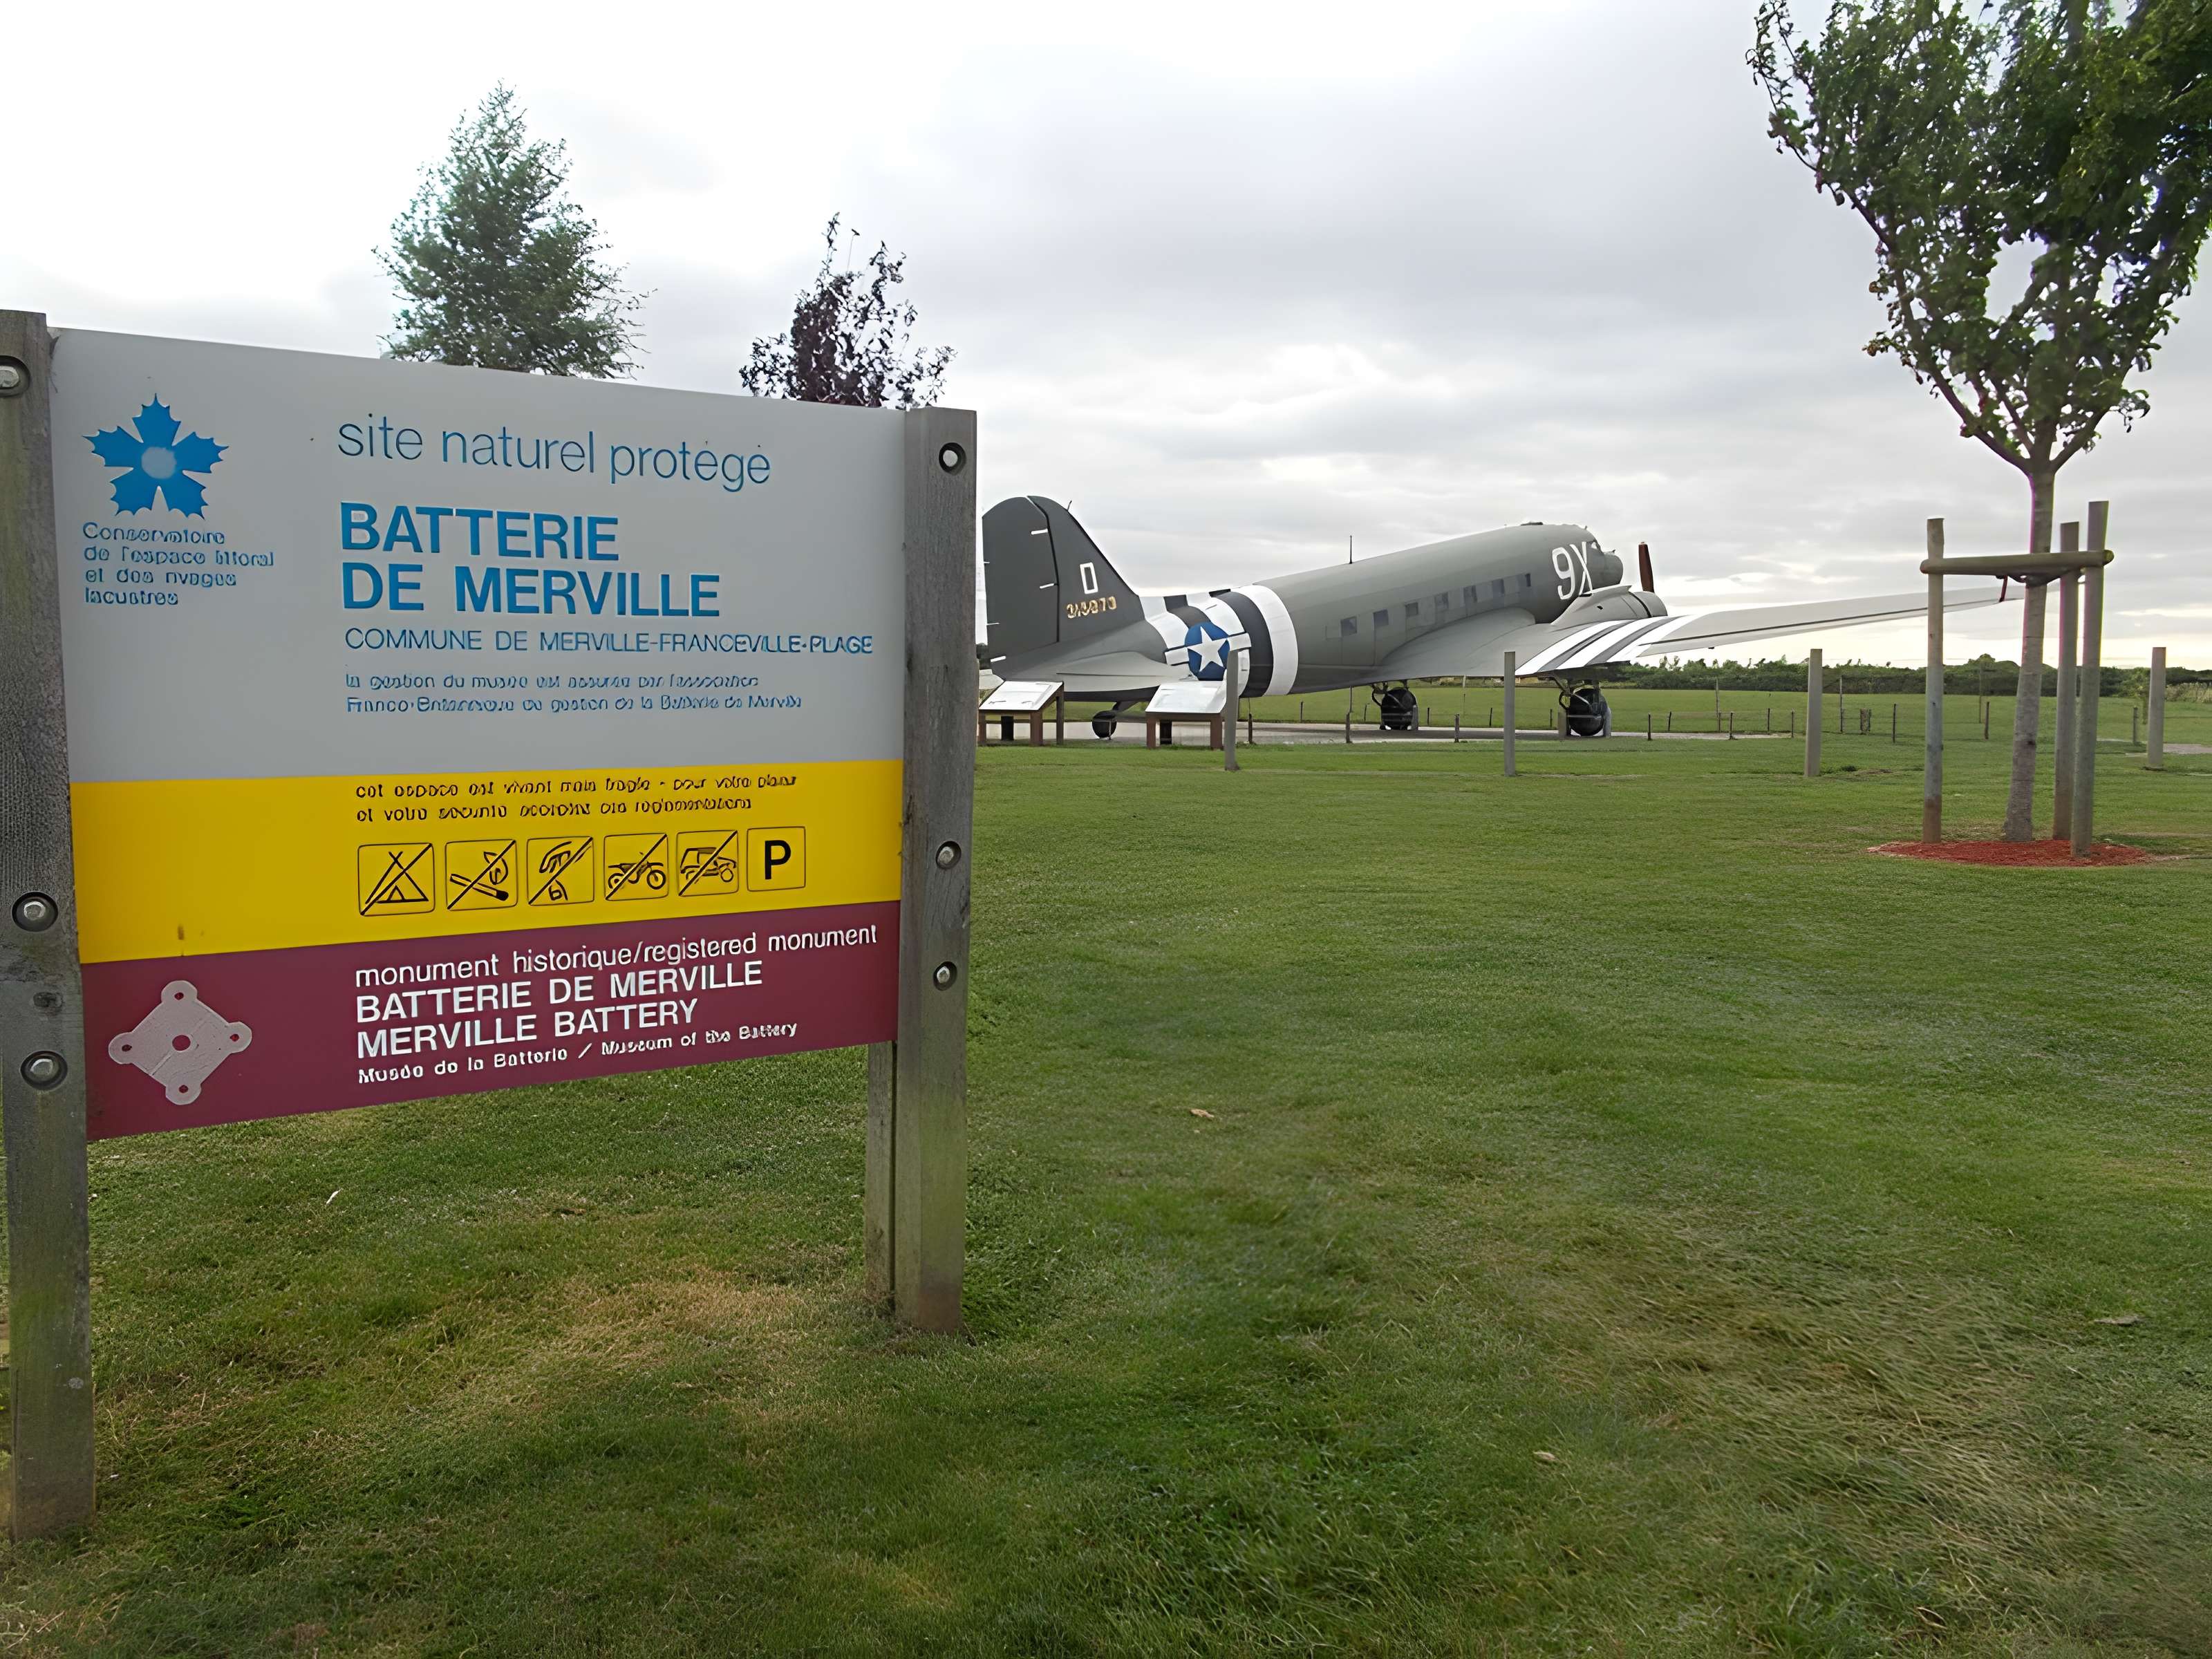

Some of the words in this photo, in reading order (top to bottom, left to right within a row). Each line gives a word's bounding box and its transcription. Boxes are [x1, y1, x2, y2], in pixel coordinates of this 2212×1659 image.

[338, 413, 423, 460] site
[442, 426, 594, 474] naturel
[340, 502, 619, 561] BATTERIE
[342, 562, 424, 611] DE
[455, 565, 720, 617] MERVILLE
[1552, 541, 1593, 601] 9X
[345, 627, 482, 650] COMMUNE
[495, 630, 528, 651] DE
[764, 839, 791, 880] P
[355, 953, 499, 988] monument
[513, 932, 758, 973] historique/registered
[768, 924, 877, 952] monument
[355, 981, 532, 1024] BATTERIE
[549, 975, 594, 1004] DE
[610, 960, 763, 999] MERVILLE
[357, 1014, 538, 1060] MERVILLE
[554, 998, 699, 1038] BATTERY
